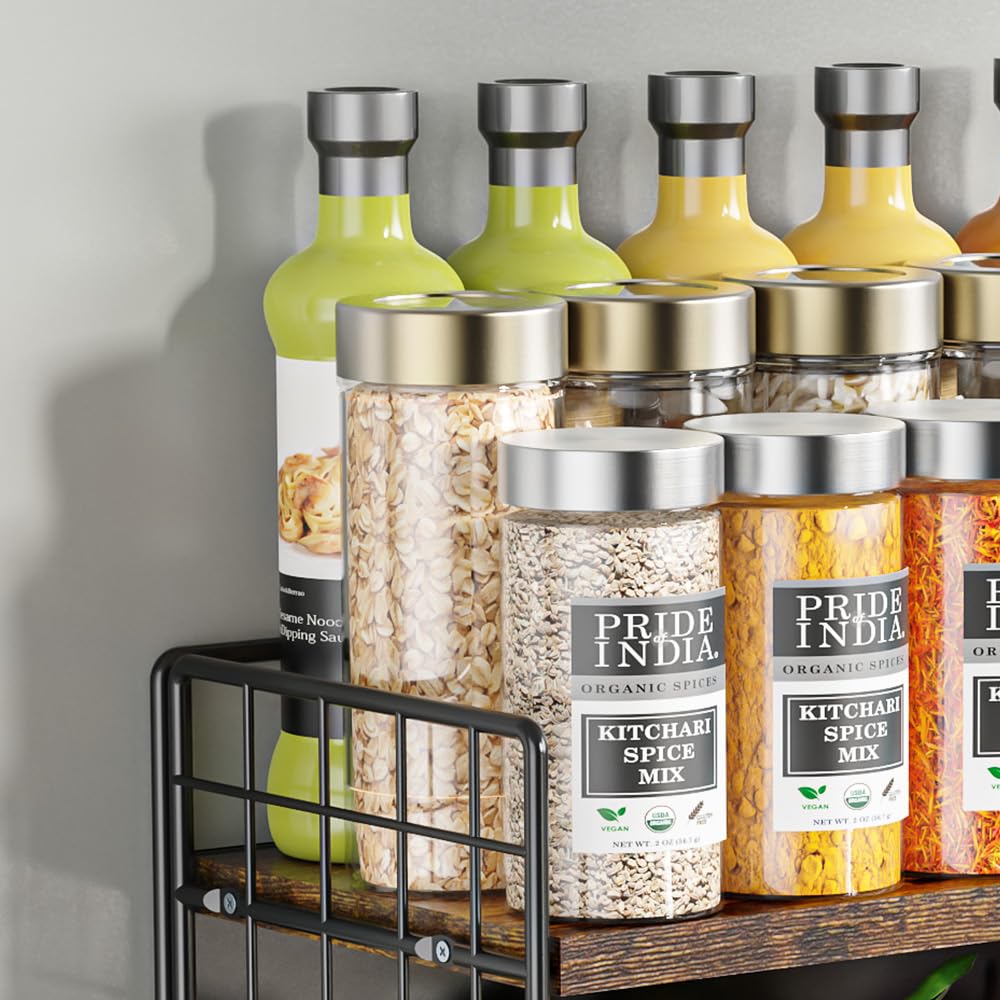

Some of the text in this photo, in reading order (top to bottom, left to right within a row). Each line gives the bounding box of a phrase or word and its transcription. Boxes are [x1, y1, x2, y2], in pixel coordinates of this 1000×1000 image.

[795, 587, 902, 621] PRIDE
[594, 606, 714, 640] PRIDE
[783, 655, 905, 674] ORGANIC SPICES
[581, 676, 717, 694] ORGANIC SPICES
[799, 696, 900, 720] KITCHARI
[598, 718, 711, 741] KITCHARI
[824, 721, 888, 742] SPICE
[623, 743, 695, 764] SPICE
[838, 744, 880, 763] MIX
[638, 766, 685, 785] MIX
